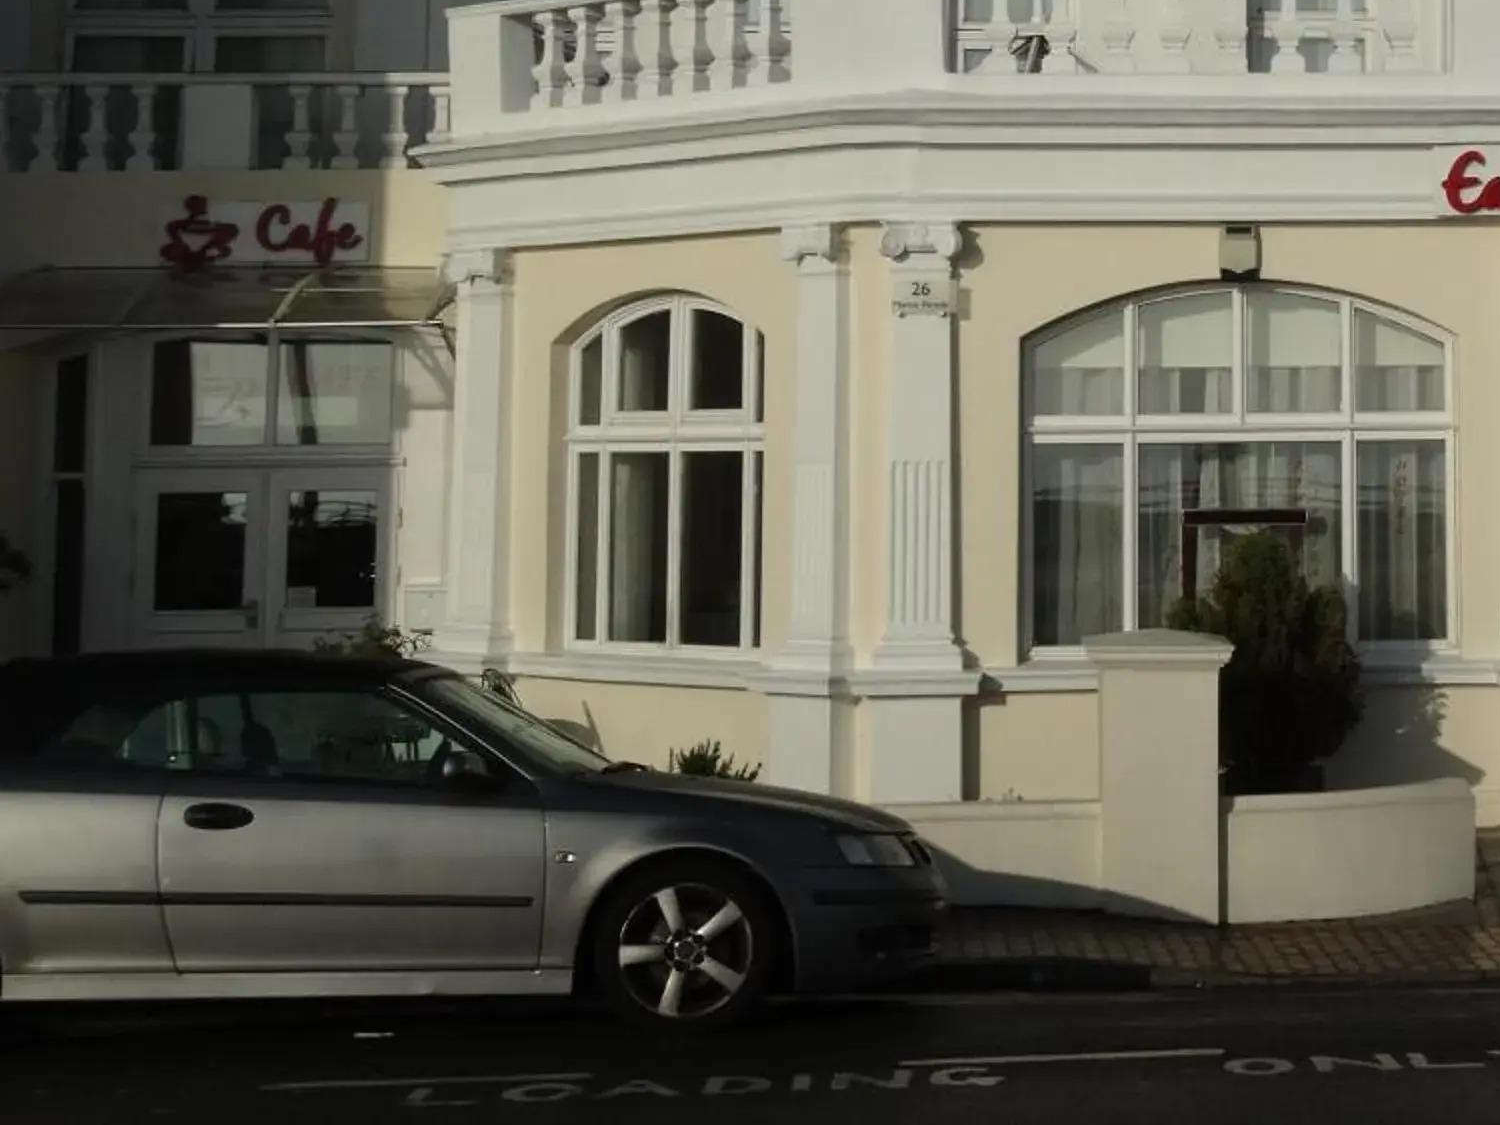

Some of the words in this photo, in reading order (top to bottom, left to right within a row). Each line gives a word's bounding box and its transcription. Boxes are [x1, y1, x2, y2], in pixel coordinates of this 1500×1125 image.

[255, 197, 364, 264] Cafe
[911, 282, 931, 296] 26
[403, 1067, 1005, 1107] LOADING
